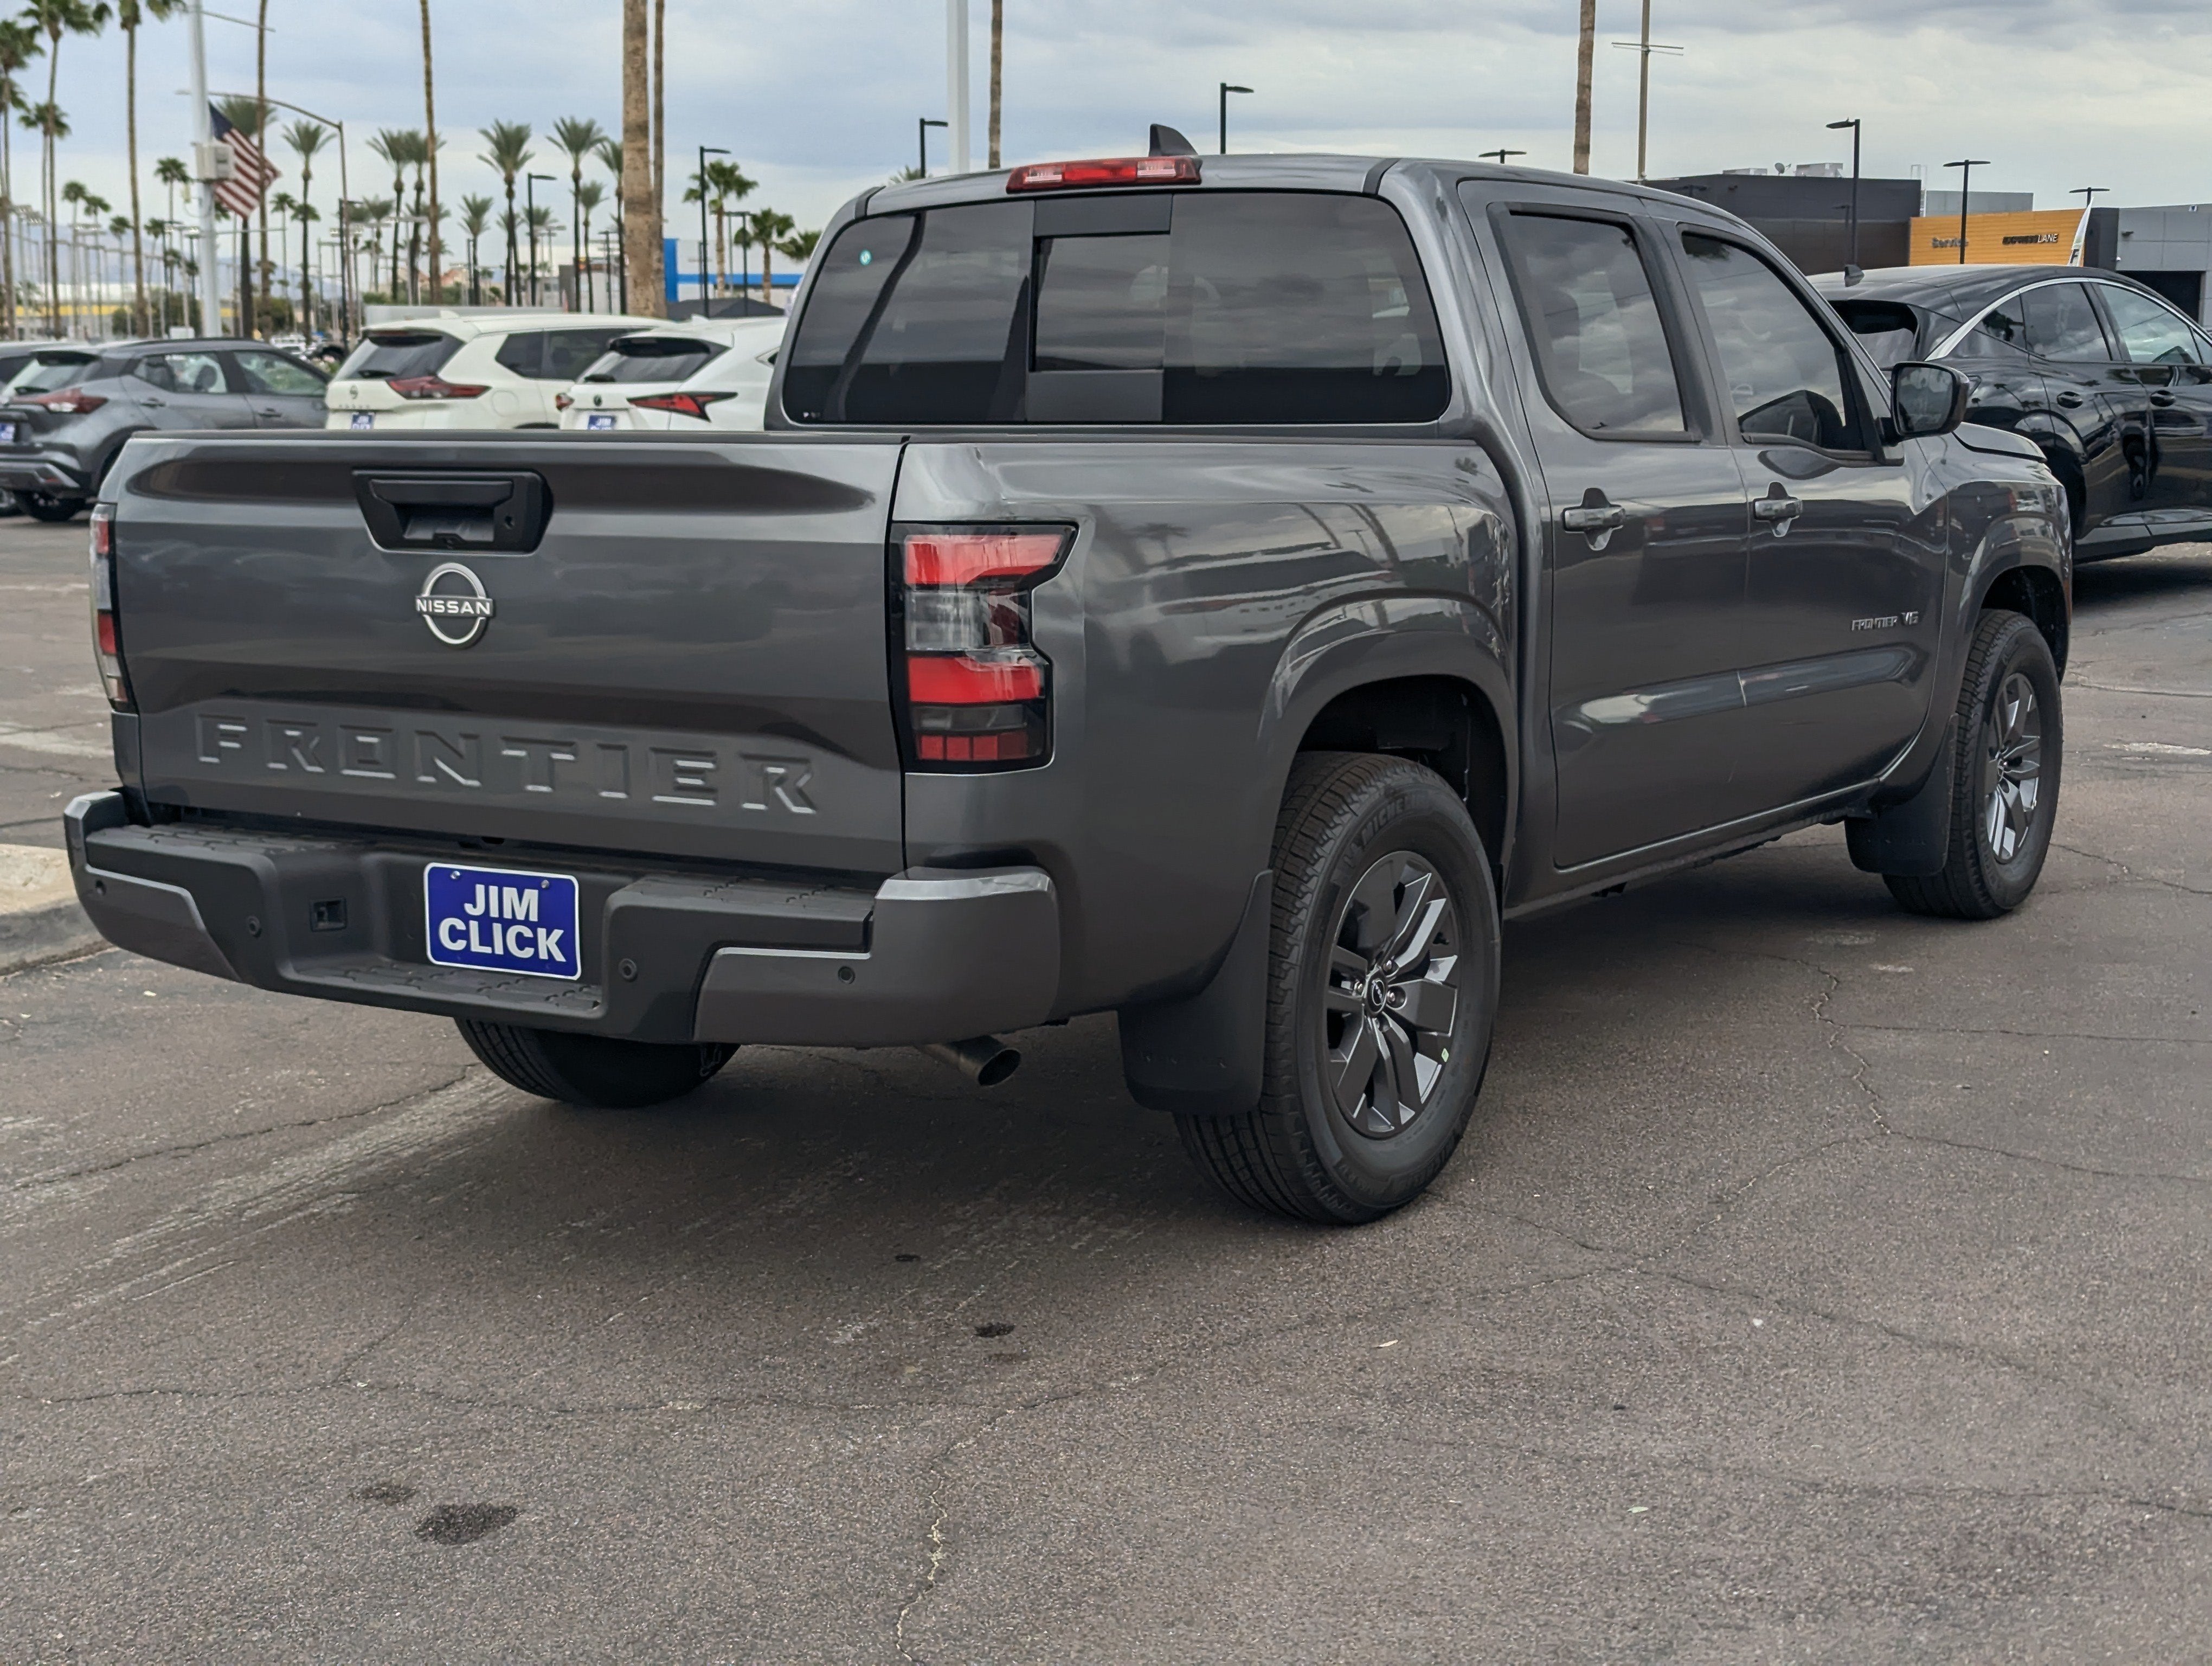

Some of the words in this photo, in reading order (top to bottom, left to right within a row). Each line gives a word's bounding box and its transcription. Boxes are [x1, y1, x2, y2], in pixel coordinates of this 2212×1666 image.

[2037, 233, 2058, 243] LANE
[416, 599, 490, 615] NISSAN
[1901, 611, 1919, 625] V6
[196, 714, 816, 813] FRONTIER
[464, 883, 539, 922] JIM
[438, 917, 567, 963] CLICK
